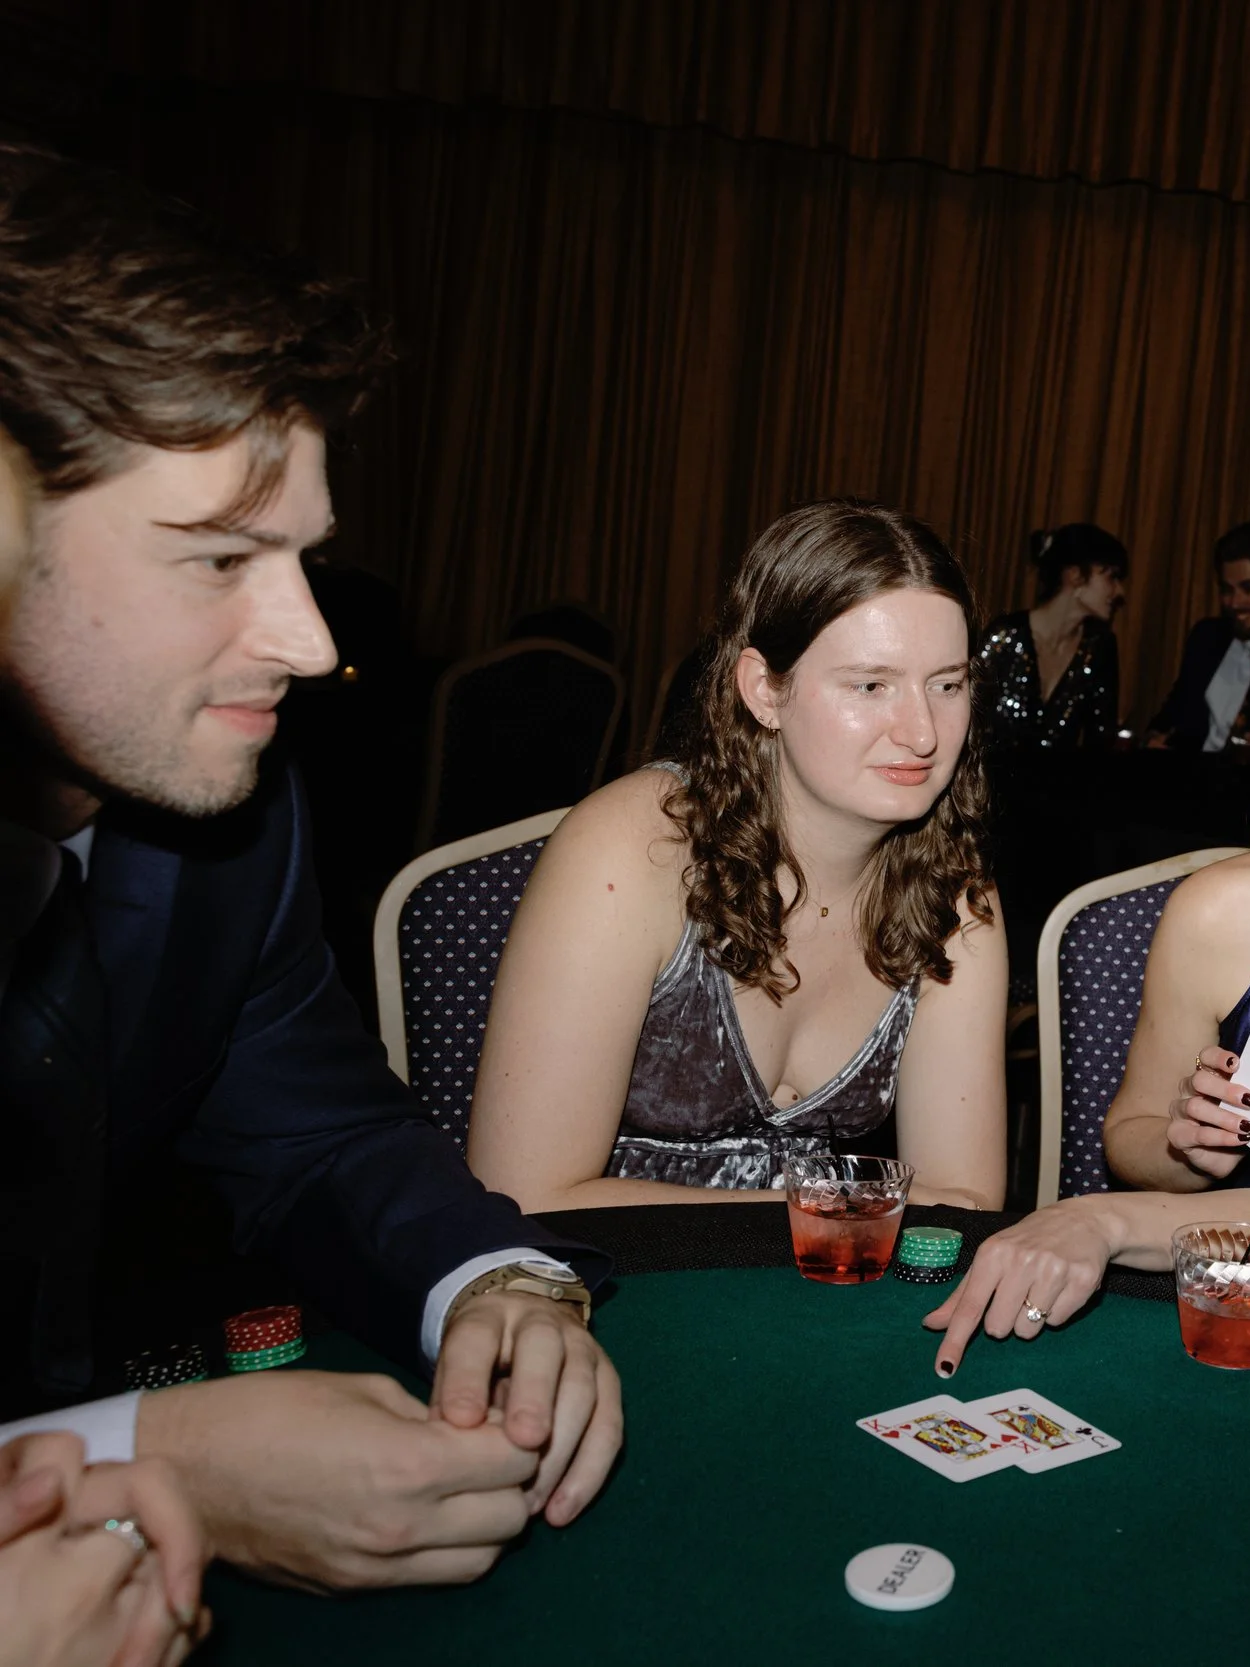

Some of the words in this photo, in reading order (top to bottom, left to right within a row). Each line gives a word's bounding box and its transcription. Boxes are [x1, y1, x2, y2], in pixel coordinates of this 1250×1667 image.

[864, 1418, 890, 1432] K
[1013, 1440, 1040, 1454] K
[1091, 1436, 1107, 1448] J
[876, 1548, 927, 1594] DEALER
